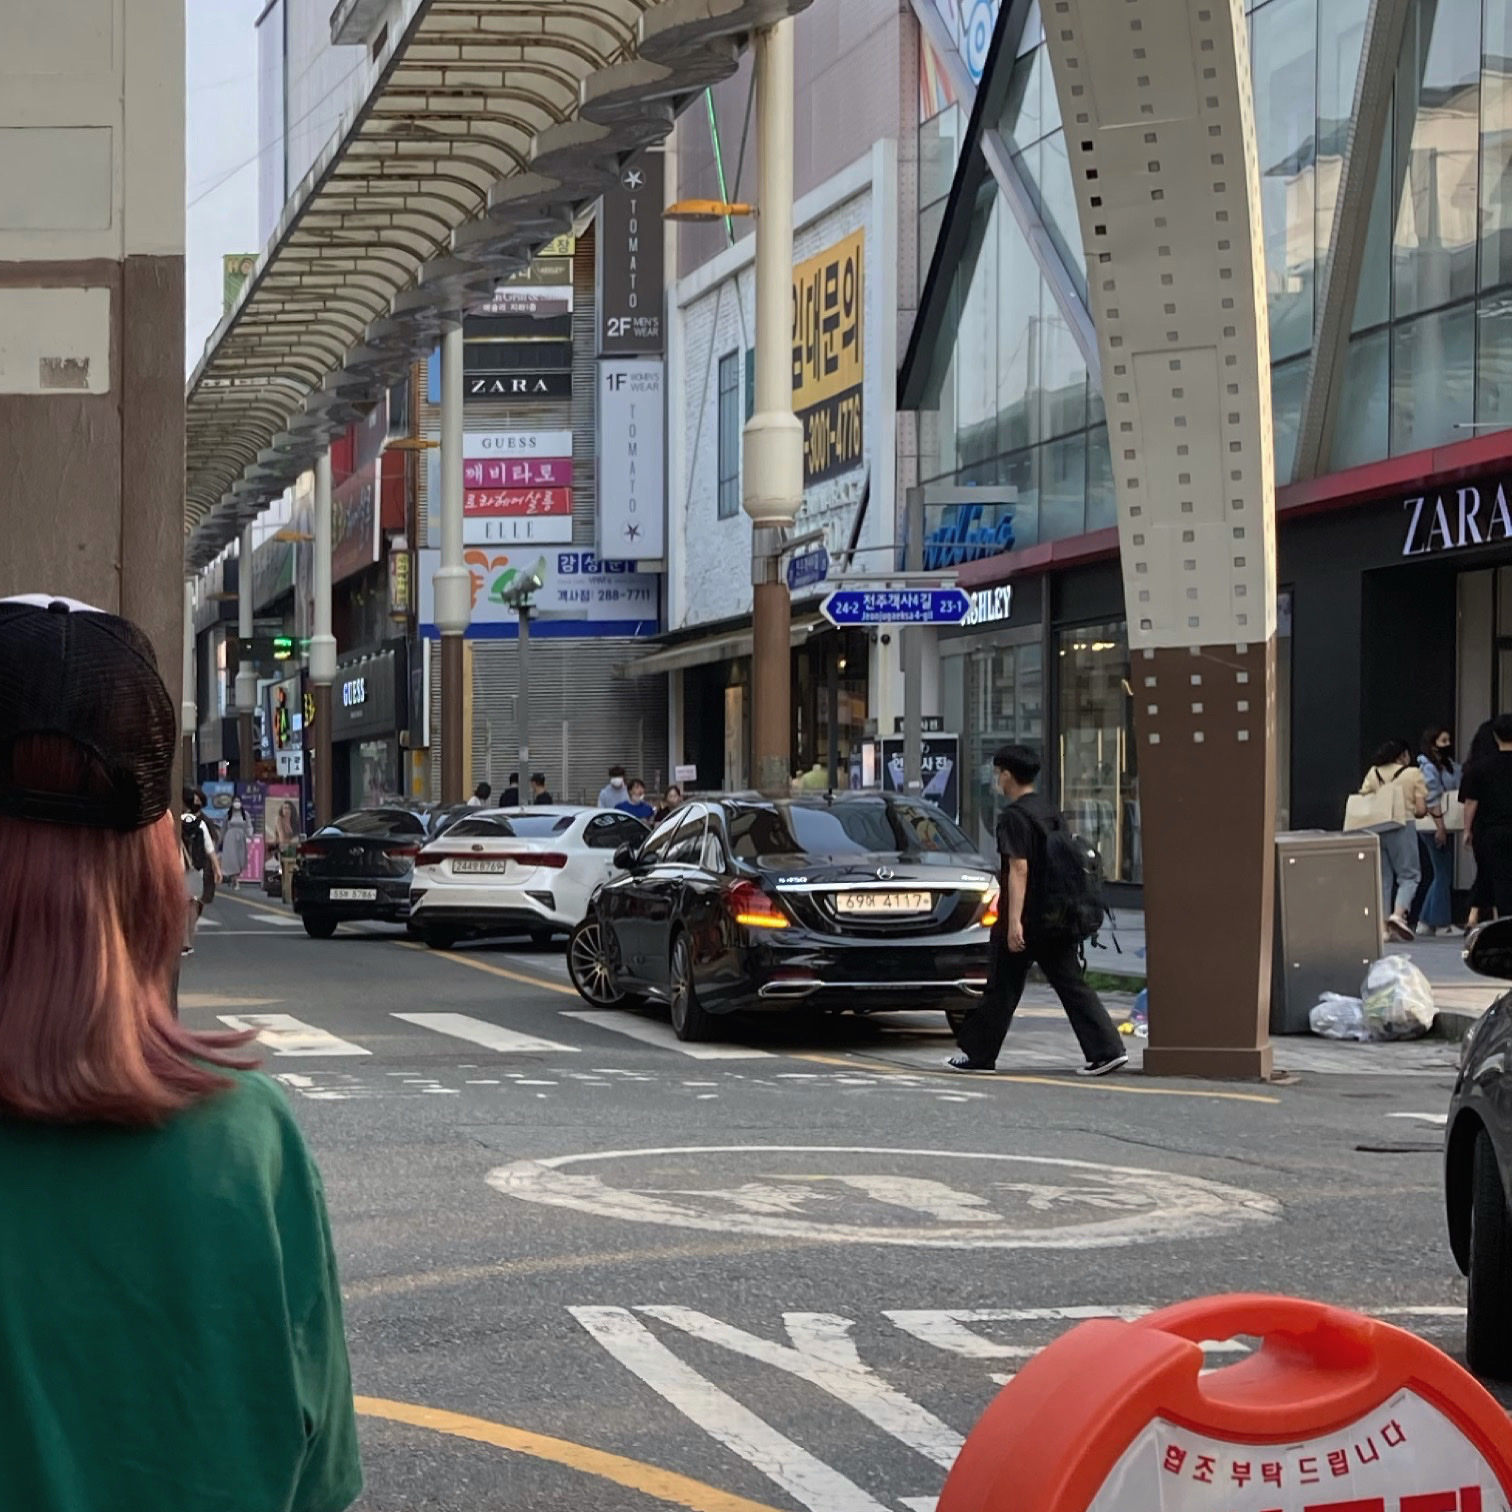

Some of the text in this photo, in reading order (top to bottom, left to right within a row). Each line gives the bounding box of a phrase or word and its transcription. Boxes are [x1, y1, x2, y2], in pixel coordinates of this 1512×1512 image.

[628, 199, 638, 309] TOMATO
[607, 316, 659, 337] 2F MEN'S
[792, 244, 861, 391] 임대문의
[633, 327, 659, 337] WEAR
[471, 378, 549, 393] ZARA
[606, 373, 628, 392] 1F
[630, 382, 660, 392] WEAR
[481, 437, 537, 449] GUESS
[628, 403, 637, 513] TOMATO
[465, 462, 555, 485] 깨비타로
[1402, 481, 1512, 556] ZARA
[485, 521, 534, 539] ELLE
[835, 601, 859, 614] 24-2
[863, 592, 932, 610] 전주객사4길
[940, 600, 962, 613] 23-1
[343, 677, 365, 707] GUESS
[883, 893, 922, 908] 4117
[1163, 1444, 1217, 1485] 협조
